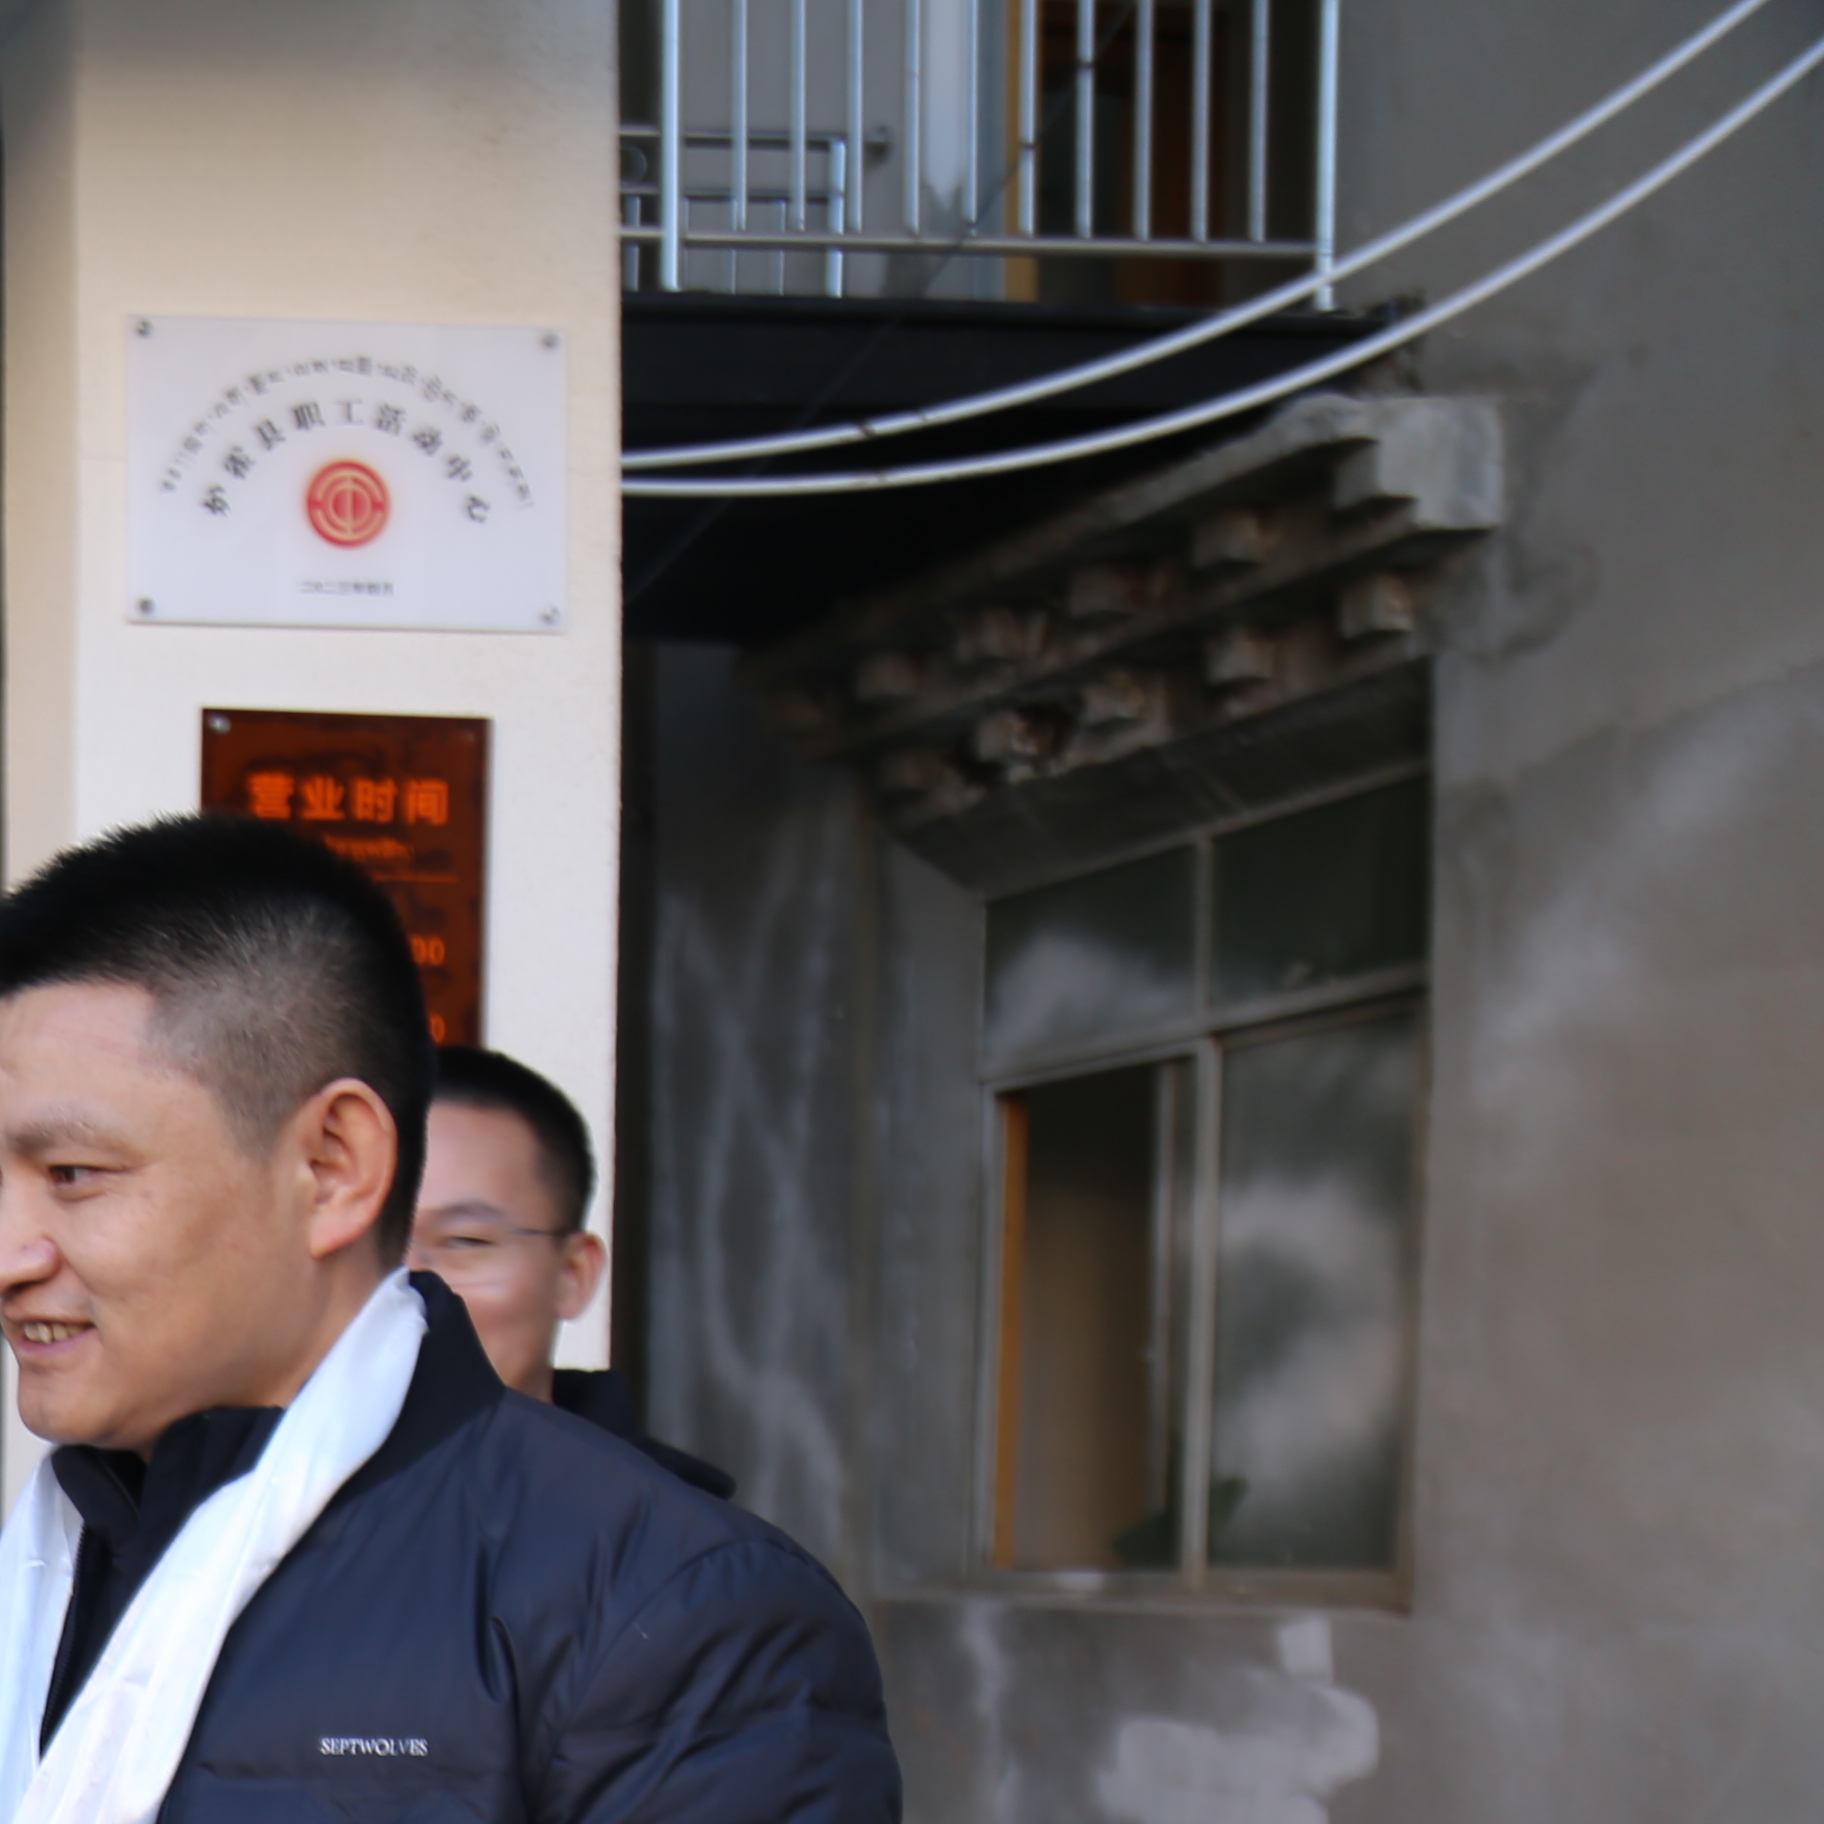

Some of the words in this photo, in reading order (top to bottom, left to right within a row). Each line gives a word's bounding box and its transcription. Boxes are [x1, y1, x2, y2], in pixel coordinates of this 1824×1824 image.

[202, 400, 490, 523] 炉霍县职工活动中心
[248, 772, 449, 826] 营业时间
